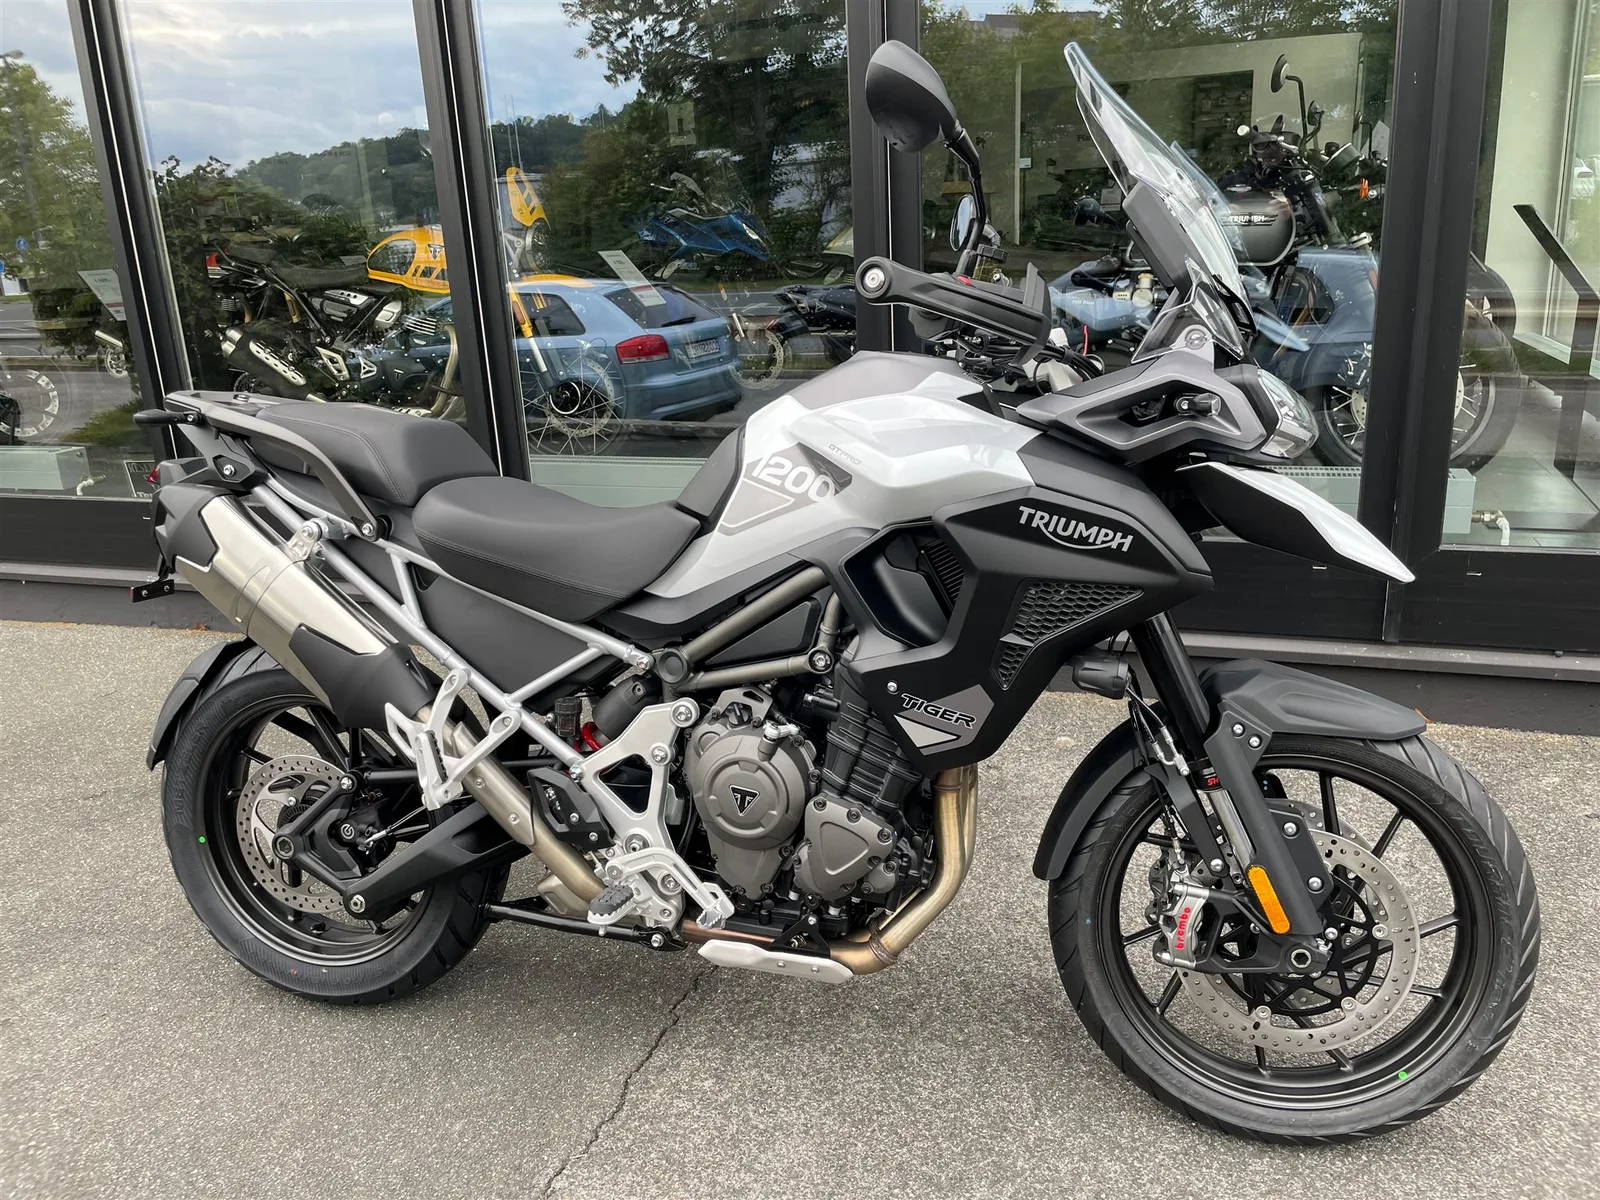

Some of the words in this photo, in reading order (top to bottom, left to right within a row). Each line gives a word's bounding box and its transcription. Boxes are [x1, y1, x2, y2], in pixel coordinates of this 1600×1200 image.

[751, 456, 835, 502] 1200
[1018, 505, 1134, 552] TRIUMPH
[900, 692, 977, 730] TIGER
[1174, 906, 1192, 950] brembo
